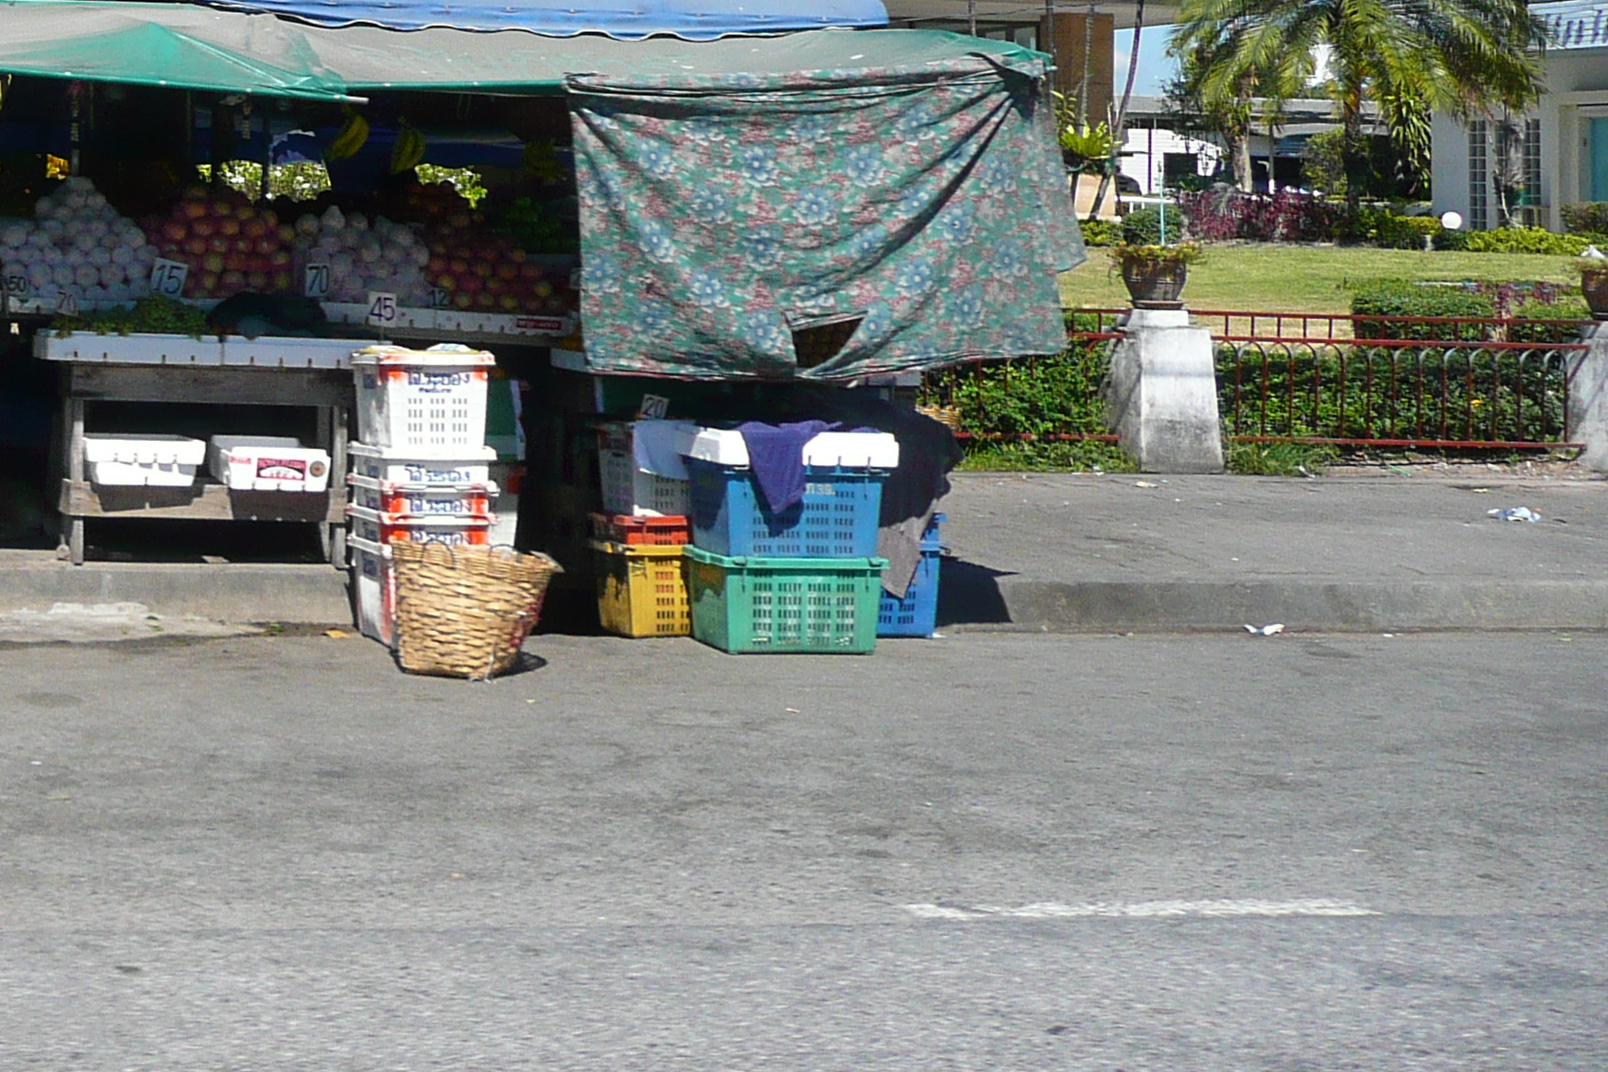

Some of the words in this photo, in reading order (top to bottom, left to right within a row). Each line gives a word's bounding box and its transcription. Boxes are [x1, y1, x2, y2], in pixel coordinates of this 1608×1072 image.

[7, 275, 27, 292] 50
[153, 264, 184, 295] 15
[308, 264, 329, 293] 70
[368, 295, 396, 321] 45
[432, 289, 448, 306] 12
[643, 396, 665, 419] 20
